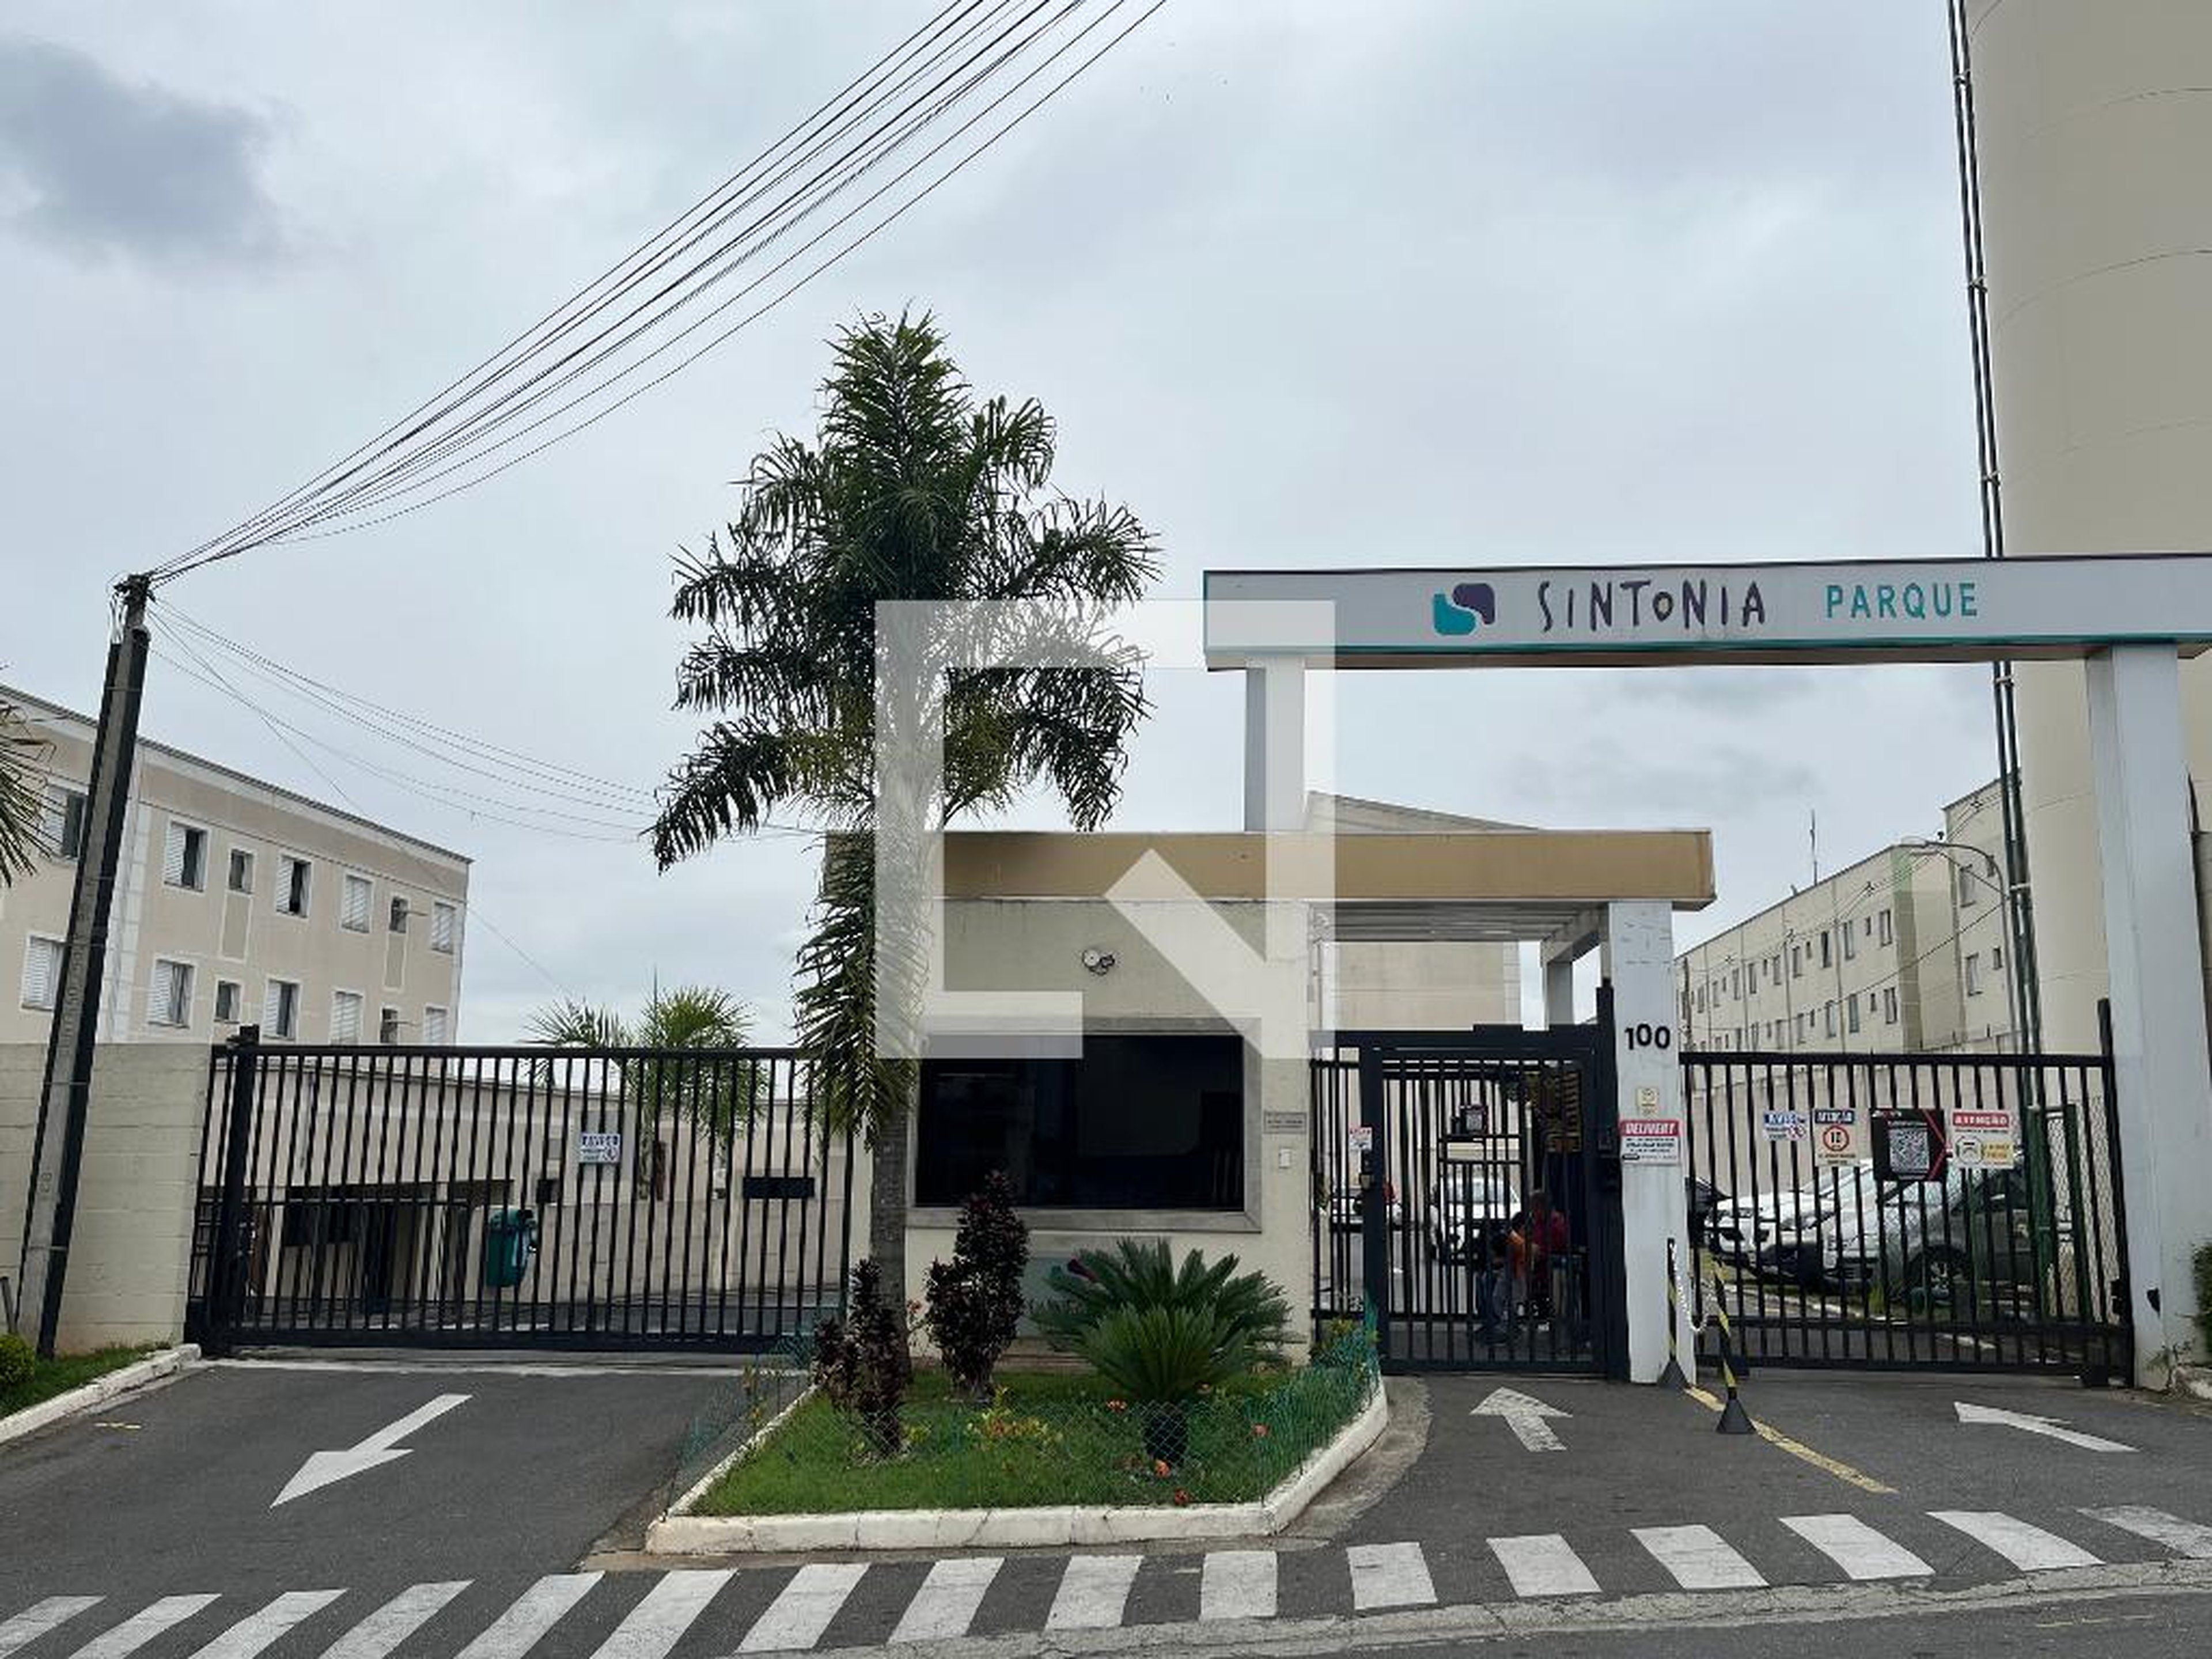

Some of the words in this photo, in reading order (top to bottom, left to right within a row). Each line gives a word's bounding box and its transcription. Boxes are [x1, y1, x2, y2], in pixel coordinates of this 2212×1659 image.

[1537, 579, 1766, 632] SINTONIA
[1826, 582, 1978, 620] PARQUE
[1624, 1023, 1670, 1050] 100
